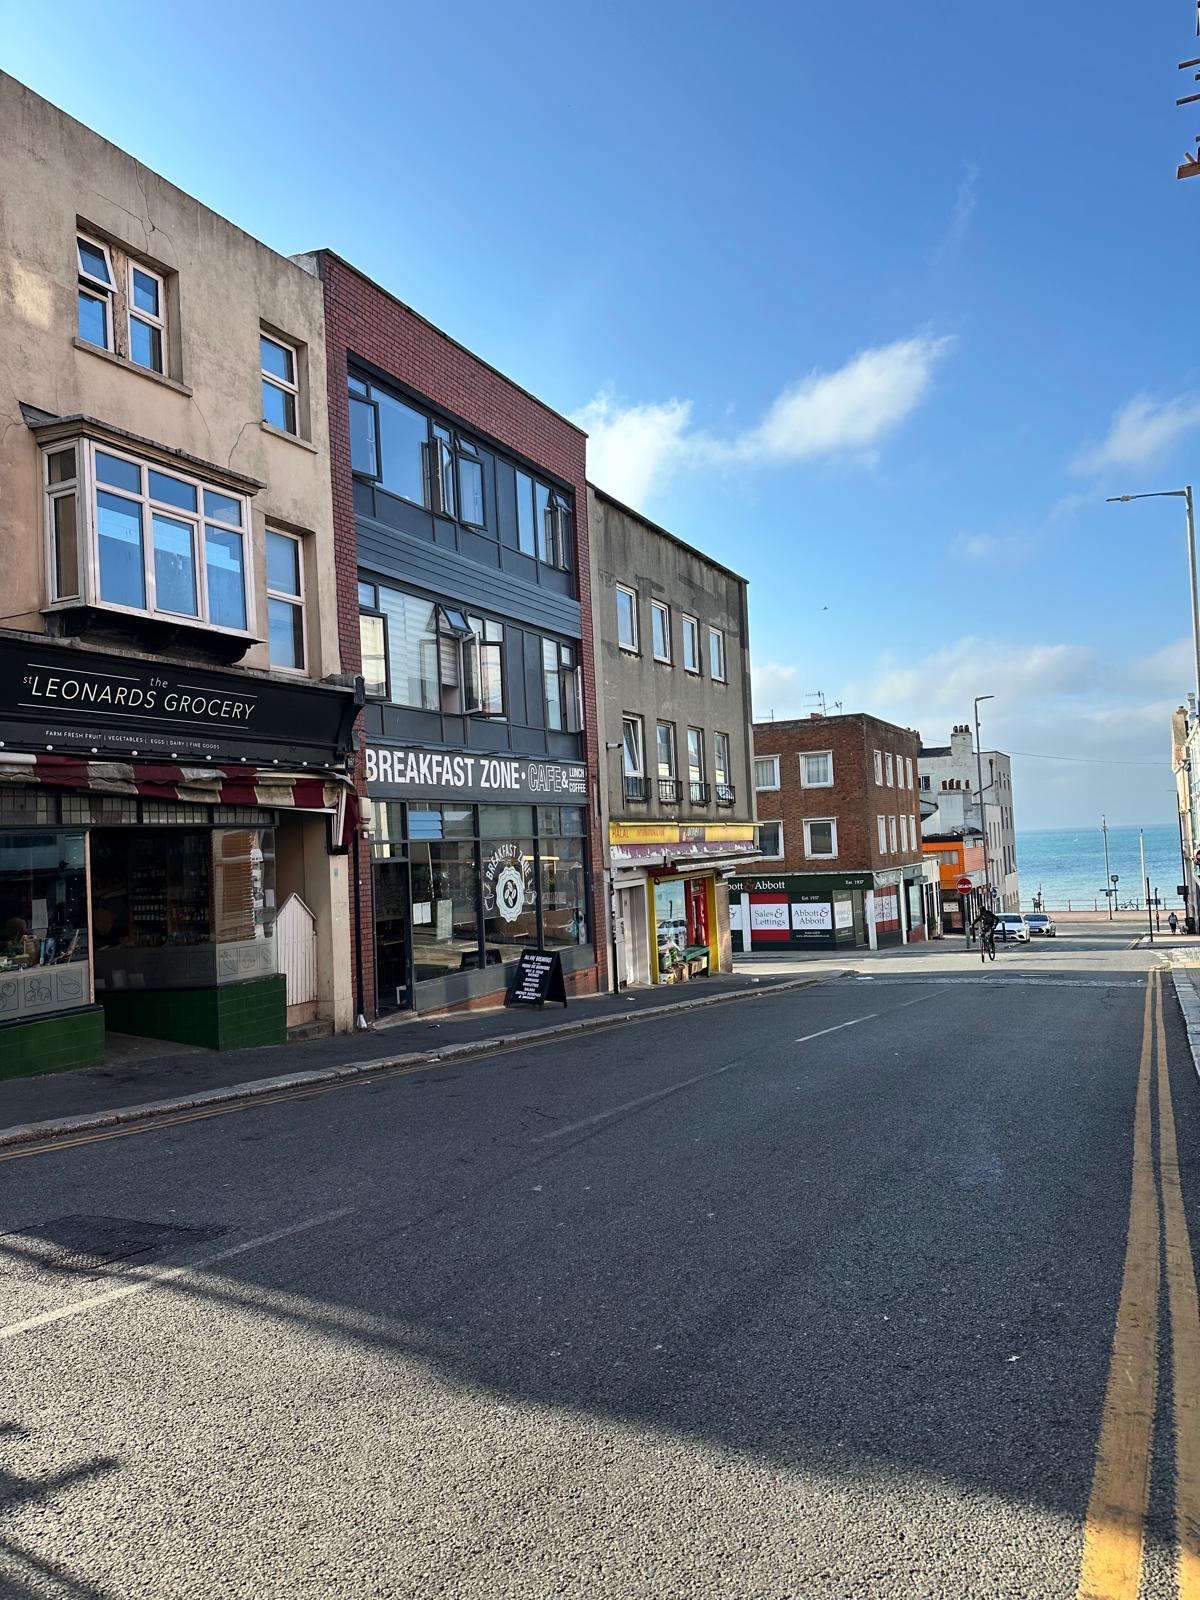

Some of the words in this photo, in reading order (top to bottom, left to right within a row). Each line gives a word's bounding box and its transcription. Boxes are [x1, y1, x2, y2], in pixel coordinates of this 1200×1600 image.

[150, 677, 169, 688] the
[31, 676, 157, 709] LEONARDS
[164, 693, 255, 720] GROCERY
[64, 731, 83, 739] FRESH
[108, 735, 143, 743] VEGETABLES
[365, 748, 475, 787] BREAKFAST
[480, 759, 520, 789] ZONE
[527, 763, 562, 792] CAFE
[561, 770, 569, 788] &
[569, 767, 585, 778] LUNCH
[569, 782, 587, 793] COFFEE
[485, 843, 517, 881] BREAKFAST
[754, 880, 785, 891] Abbott
[774, 907, 784, 919] &
[819, 907, 829, 918] &
[755, 919, 786, 927] Lettings
[799, 917, 825, 925] Abbott
